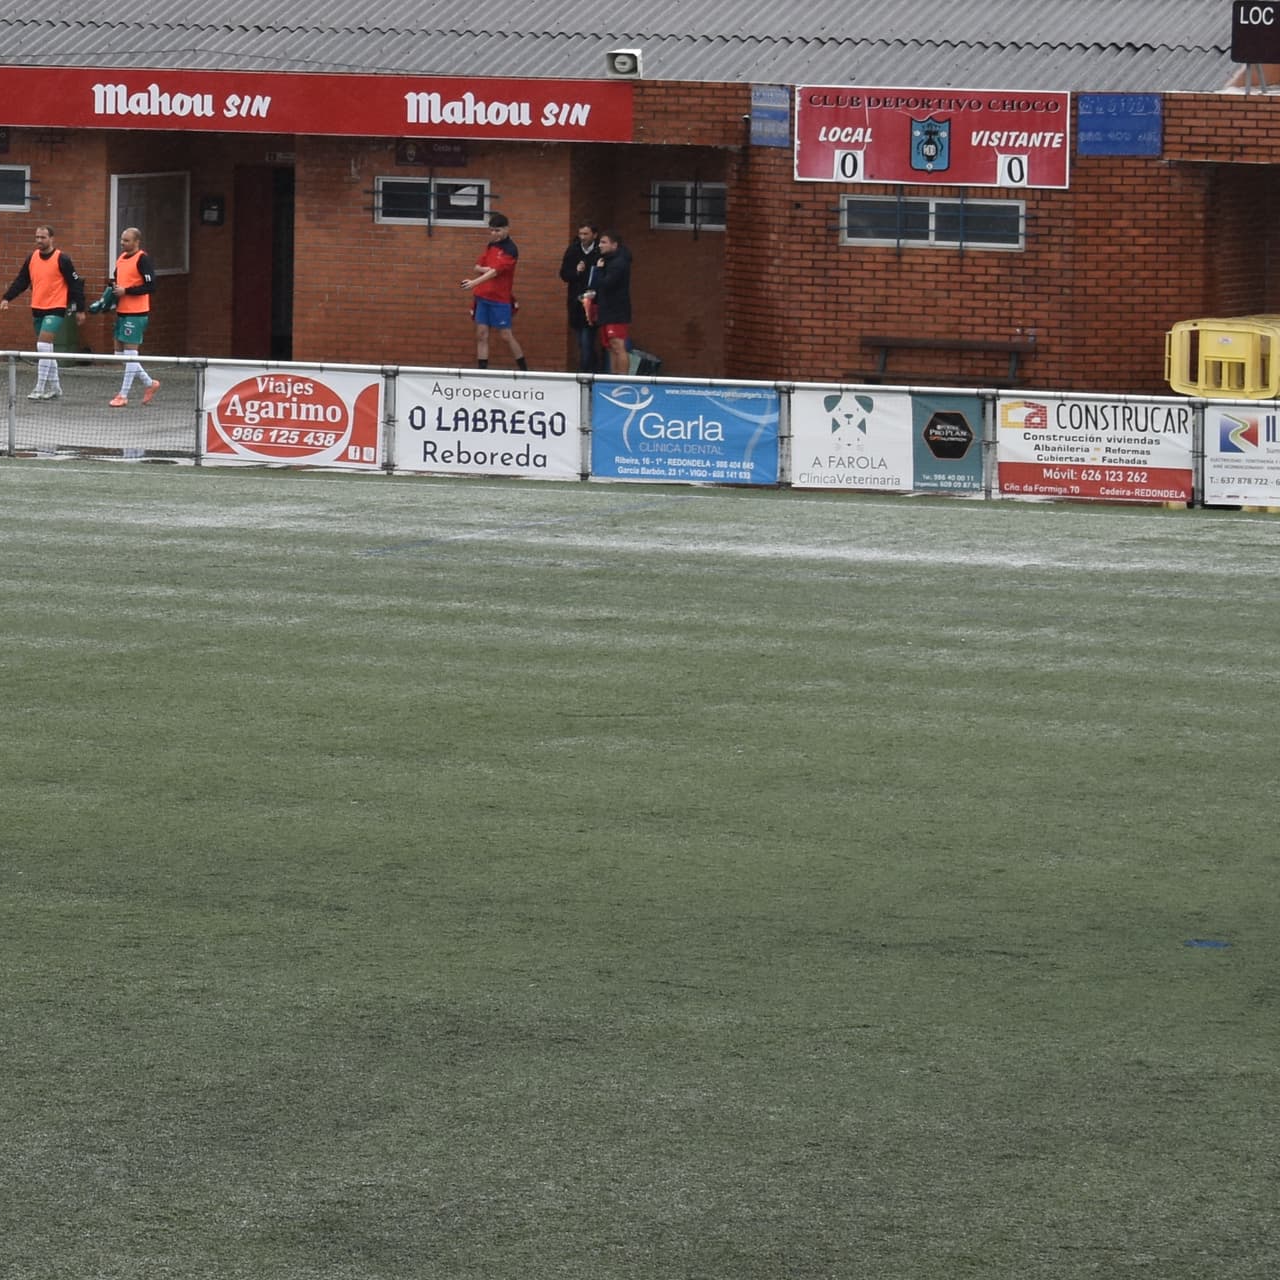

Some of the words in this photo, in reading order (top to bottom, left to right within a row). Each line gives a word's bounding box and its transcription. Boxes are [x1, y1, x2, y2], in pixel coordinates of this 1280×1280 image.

[1240, 6, 1274, 25] LOC
[92, 83, 215, 117] Mahou
[223, 93, 272, 118] SIN
[404, 91, 533, 126] Mahou
[540, 102, 591, 127] SIN
[808, 95, 862, 109] CLUB
[866, 96, 984, 113] DEPORTIVO
[988, 99, 1061, 114] CHOCO
[818, 126, 873, 143] LOCAL
[971, 131, 1065, 148] VISITANTE
[840, 152, 858, 179] 0
[1007, 156, 1025, 183] 0
[256, 376, 314, 398] Viajes
[431, 381, 545, 401] Agropecuaria
[224, 394, 342, 424] Agarimo
[1056, 403, 1189, 434] CONSTRUCAR
[408, 406, 426, 431] O
[436, 406, 567, 439] LABREGO
[639, 412, 725, 442] Garla
[232, 427, 264, 442] 986
[269, 429, 299, 444] 125
[303, 432, 336, 446] 438
[1023, 432, 1102, 443] Construcción
[1106, 435, 1161, 446] viviendas
[423, 440, 548, 468] Reboreda
[684, 443, 725, 455] DENTAL
[1105, 446, 1151, 456] Reformas
[667, 458, 711, 468] REDONDELA
[812, 456, 823, 468] A
[828, 456, 888, 469] FAROLA
[1037, 454, 1086, 463] Cubiertas
[1101, 456, 1148, 465] Fachadas
[690, 469, 708, 478] VIGO
[1043, 467, 1078, 480] Móvil:
[1081, 470, 1102, 481] 626
[1106, 470, 1124, 482] 123
[1127, 471, 1148, 483] 262
[1023, 484, 1033, 492] da
[1100, 486, 1186, 499] Cedeira-REDONDELA
